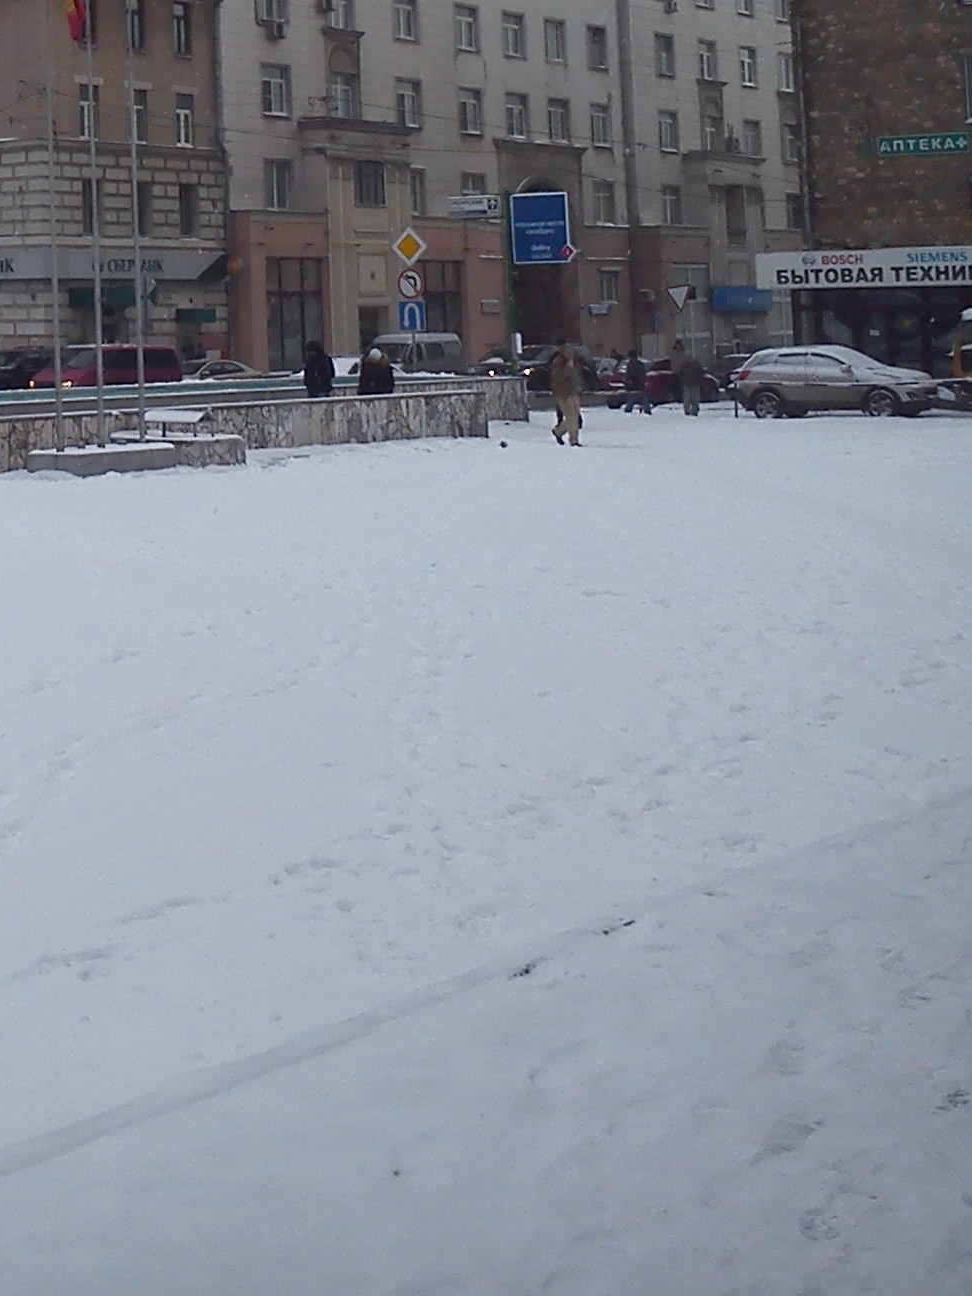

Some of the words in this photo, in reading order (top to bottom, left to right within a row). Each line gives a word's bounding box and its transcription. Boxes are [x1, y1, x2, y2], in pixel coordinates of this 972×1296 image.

[880, 137, 955, 151] АПТЕКА
[108, 258, 163, 272] СБЕРАНК
[821, 254, 864, 265] BOSCH
[906, 251, 968, 263] SIEMENS
[776, 267, 883, 284] БЫТОВАЯ
